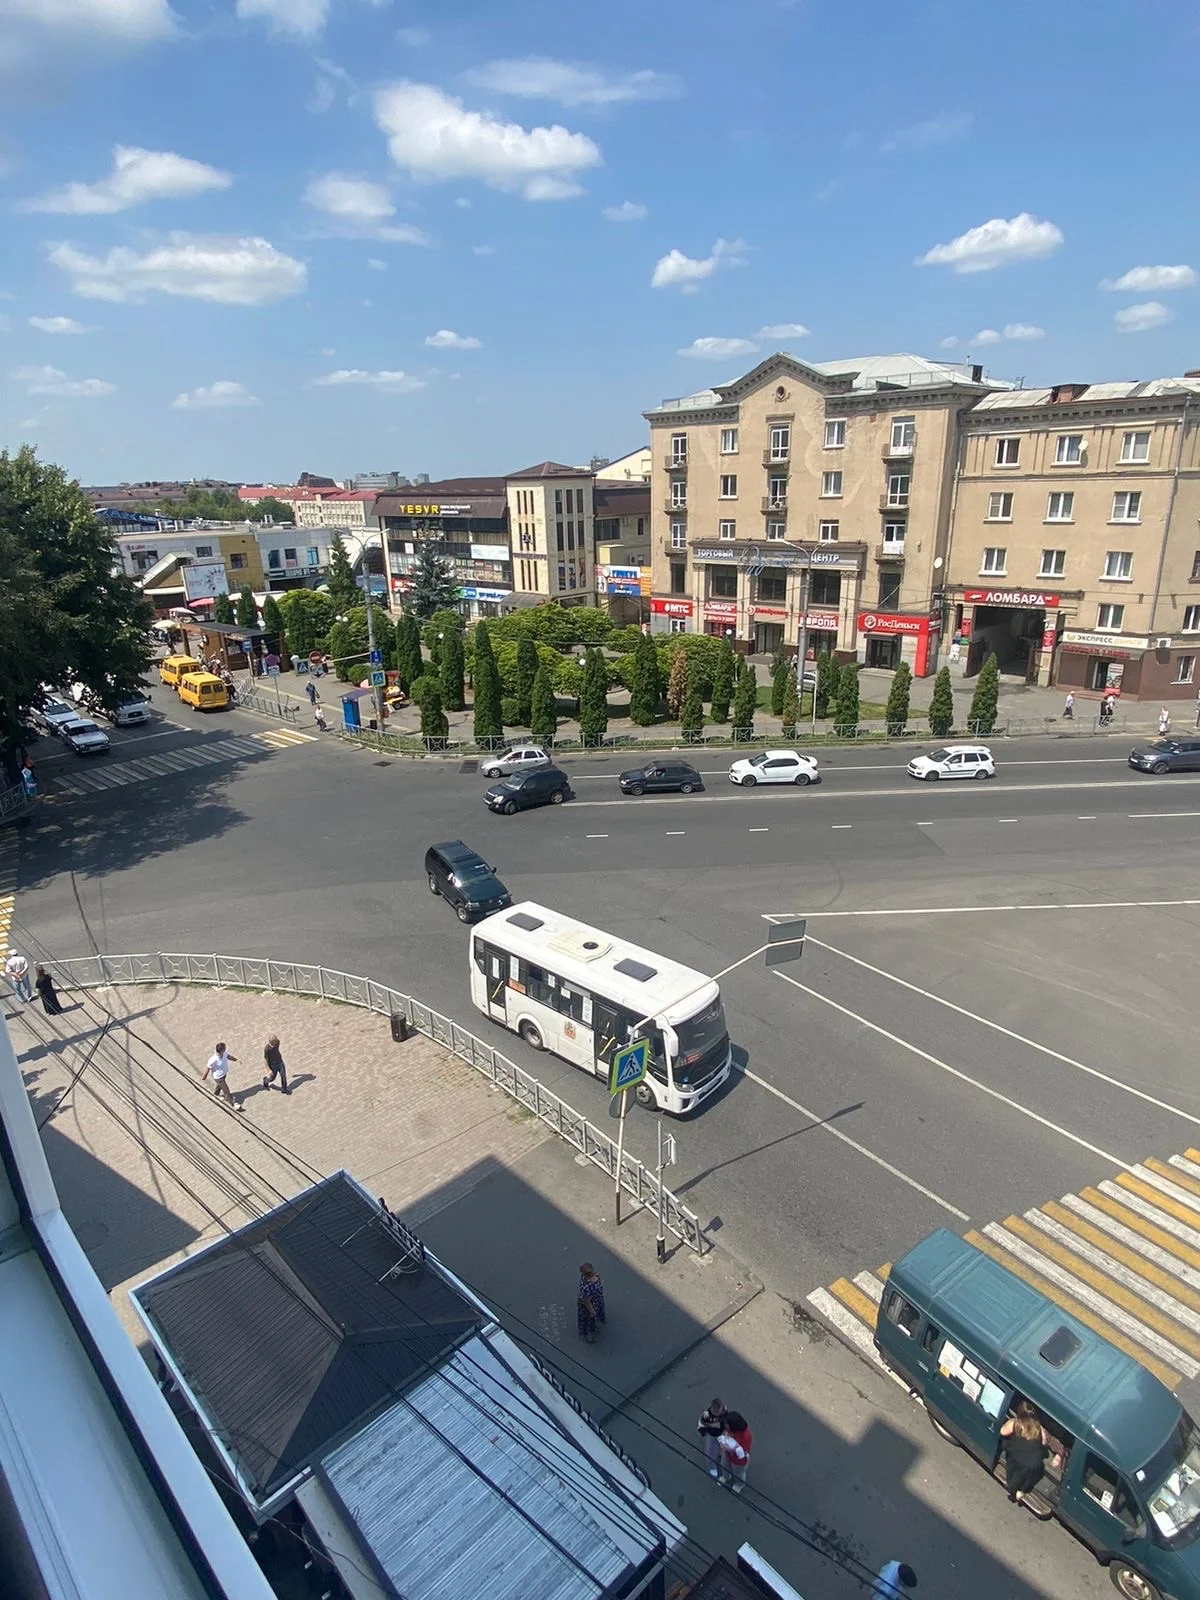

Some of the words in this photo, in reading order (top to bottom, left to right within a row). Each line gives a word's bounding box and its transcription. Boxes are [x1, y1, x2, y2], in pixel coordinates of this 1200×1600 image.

[400, 504, 439, 514] YESVR
[696, 548, 734, 558] ТОРГОВЫЙ
[811, 553, 839, 562] ЦЕНТР
[985, 592, 1045, 605] ЛОМБАРД
[670, 603, 689, 613] МТС
[878, 618, 920, 630] РосДеньги
[1077, 634, 1113, 644] ЭКСПРЕСС
